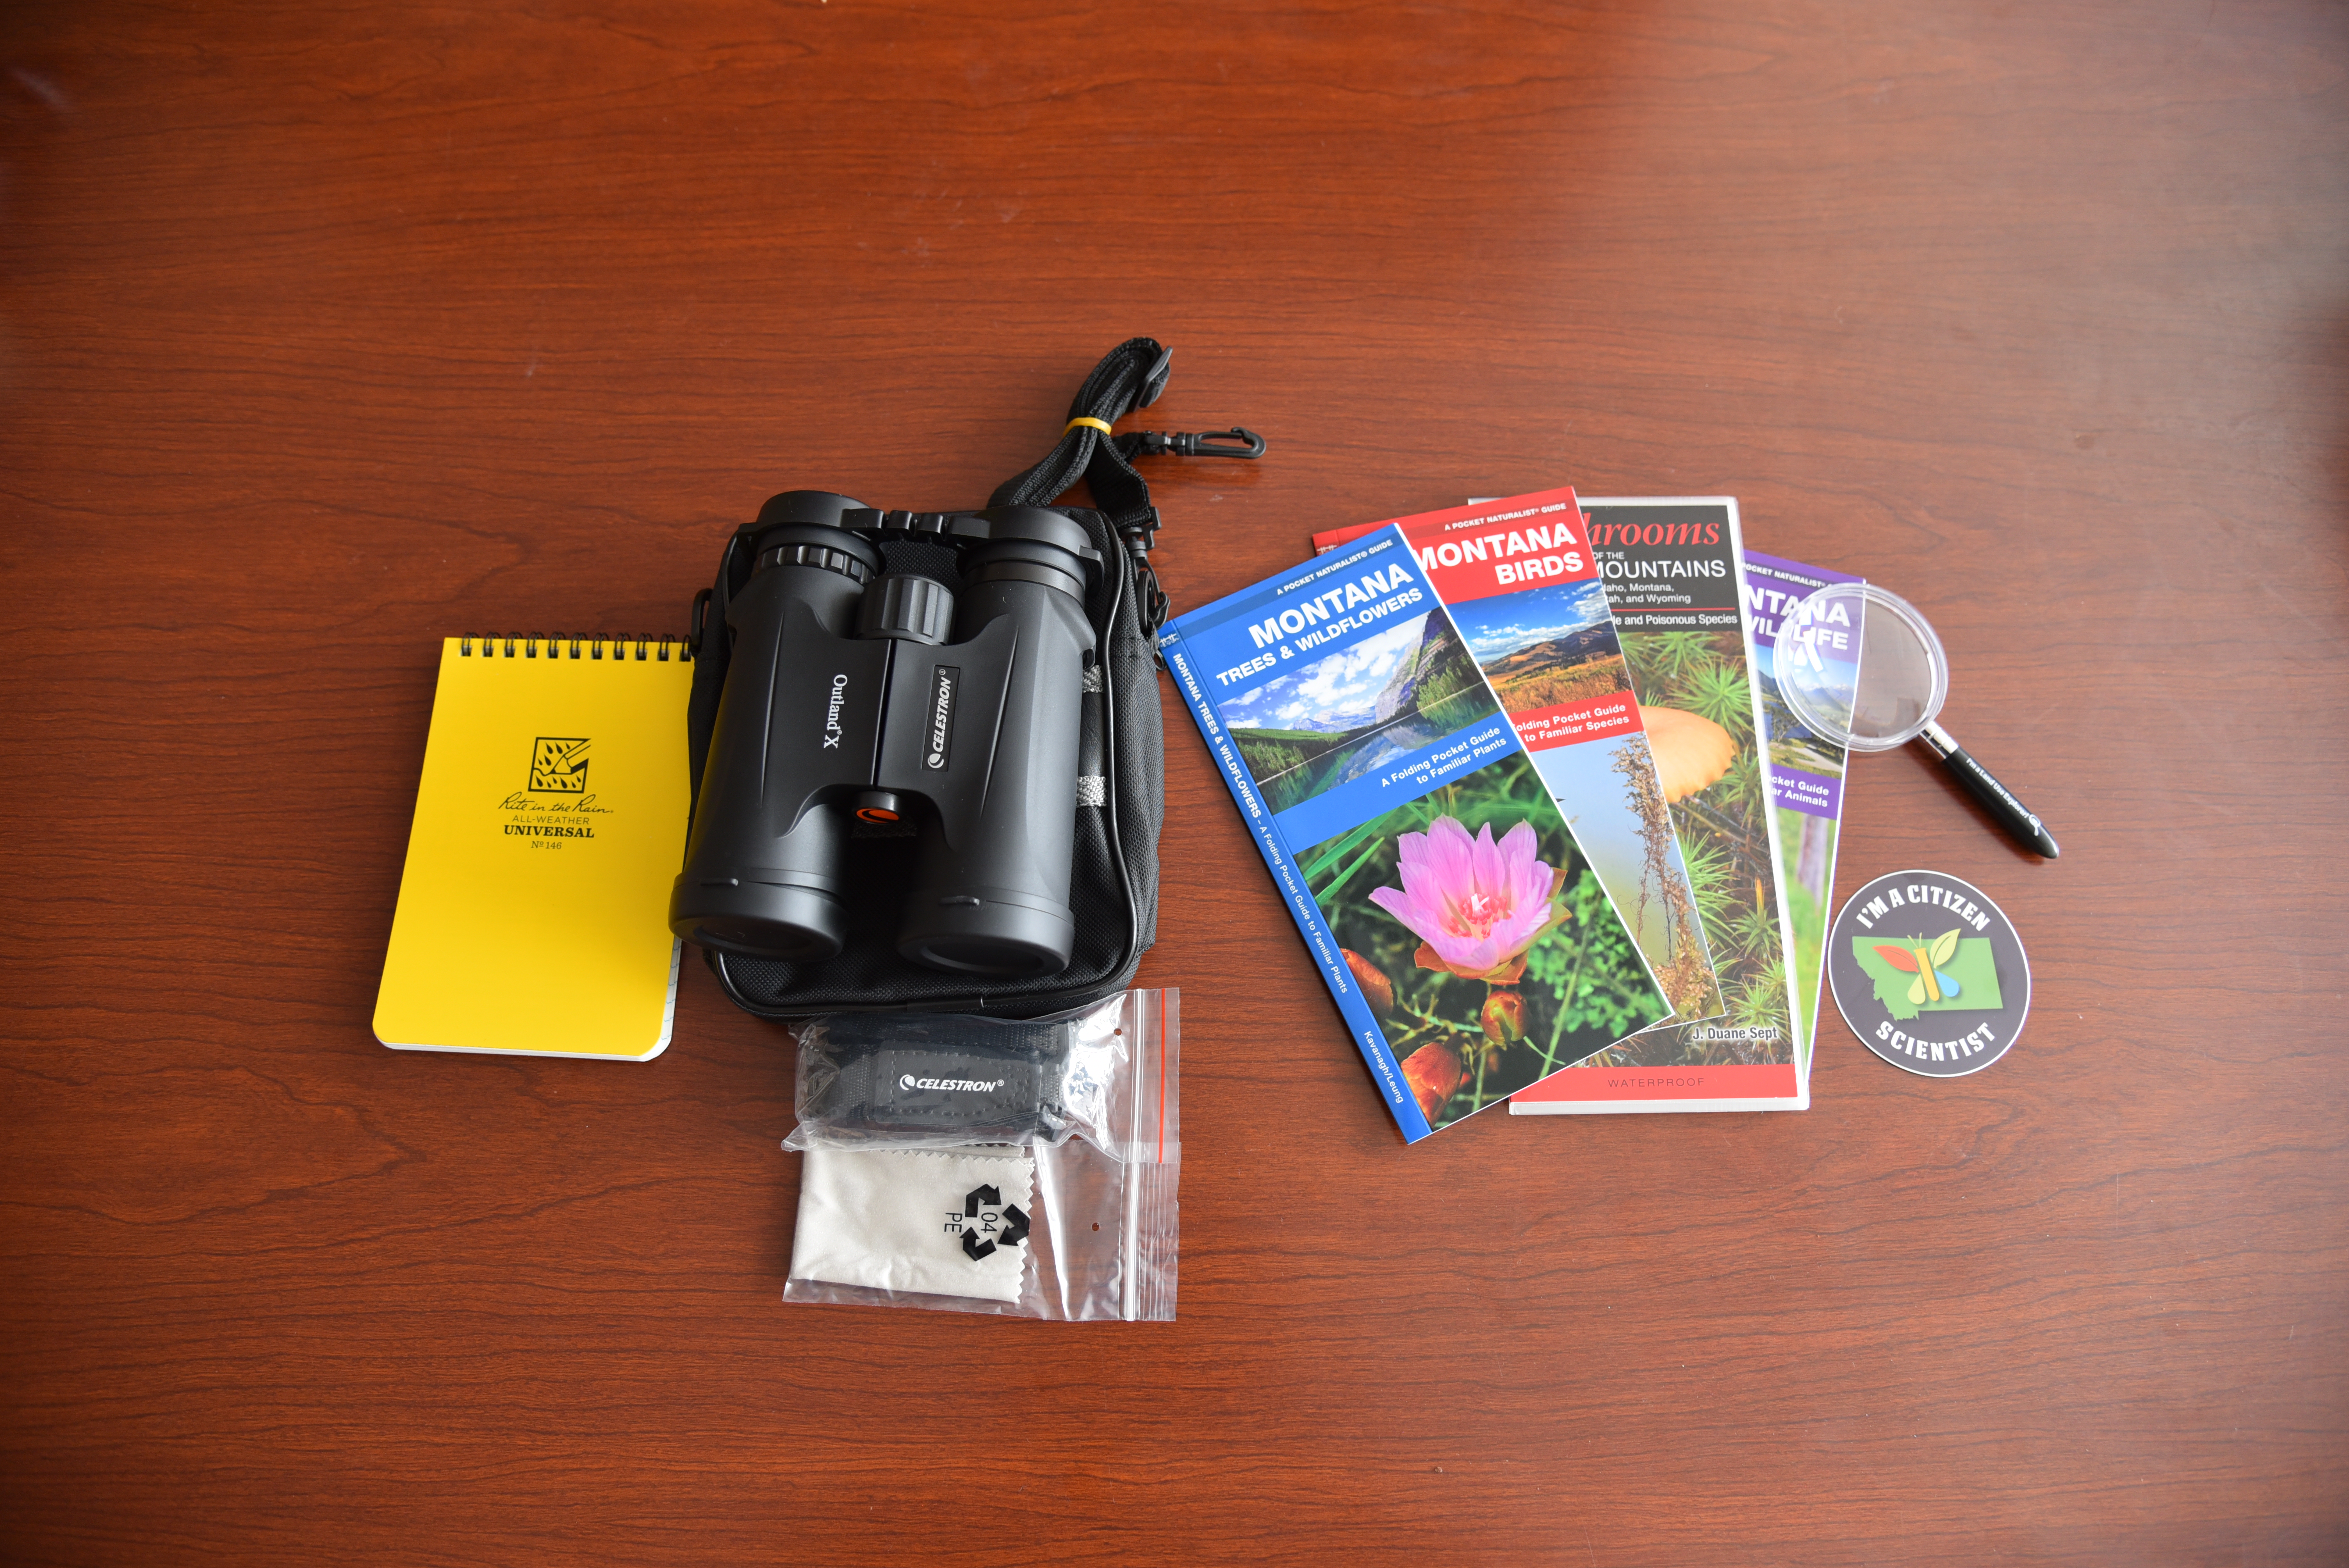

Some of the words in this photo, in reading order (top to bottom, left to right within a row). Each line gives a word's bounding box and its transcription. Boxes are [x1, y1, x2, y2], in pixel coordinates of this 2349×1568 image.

[1452, 518, 1485, 530] POCKET
[1541, 502, 1567, 514] GUIDE
[1583, 512, 1720, 546] hrooms
[1284, 574, 1315, 593] POCKET
[1368, 540, 1393, 555] GUIDE
[1495, 551, 1584, 585] BIRDS
[1593, 551, 1604, 560] OF
[1606, 551, 1625, 560] THE
[1608, 594, 1623, 604] ah,
[1626, 594, 1644, 603] and
[1646, 593, 1691, 604] Wyoming
[1629, 583, 1674, 592] Montana,
[1248, 563, 1414, 649] MONTANA
[1744, 584, 1851, 627] NTANA
[1624, 615, 1643, 625] and
[1645, 614, 1696, 625] Poisonous
[1698, 613, 1738, 626] Species
[1216, 652, 1276, 687] TREES
[1280, 645, 1295, 659] &
[1294, 588, 1423, 652] WILDFLOWERS
[1513, 720, 1550, 732] olding
[1552, 712, 1592, 725] Pocket
[1594, 704, 1626, 716] Guide
[1524, 733, 1536, 742] to
[1540, 725, 1583, 740] Familiar
[1586, 716, 1629, 731] Species
[824, 735, 839, 748] X
[1381, 777, 1389, 787] A
[1390, 760, 1430, 783] Folding
[1431, 741, 1468, 764] Pocket
[1470, 727, 1500, 745] Guide
[1416, 775, 1429, 784] to
[1430, 755, 1471, 777] Familiar
[1474, 737, 1506, 757] Plants
[498, 791, 535, 810] Rite
[549, 802, 570, 812] the
[1785, 789, 1828, 807] Animals
[1798, 781, 1829, 796] Guide
[1979, 770, 1995, 786] Land
[1993, 782, 2005, 796] Use
[2003, 792, 2029, 818] Explorer!
[504, 825, 595, 838] UNIVERSAL
[512, 815, 590, 825] ALL-WEATHER
[1173, 653, 1202, 702] MONTANA
[1198, 701, 1220, 734] TREES
[1214, 736, 1224, 745] &
[1219, 744, 1262, 818] WILDFLOWERS
[1259, 825, 1267, 834] A
[1264, 833, 1282, 865] Folding
[1280, 864, 1298, 895] Pocket
[1295, 895, 1310, 920] Guide
[1308, 920, 1315, 931] to
[1313, 931, 1334, 965] Familiar
[1331, 966, 1347, 994] Plants
[1856, 896, 1889, 929] I'M
[1889, 888, 1905, 908] A
[1907, 885, 1990, 932] CITIZEN
[1693, 1028, 1704, 1040] J.
[1707, 1028, 1746, 1040] Duane
[1749, 1026, 1777, 1041] Sept
[1875, 1021, 1995, 1061] SCIENTIST
[1364, 1031, 1404, 1104] Kavanagh/Leung
[1608, 1078, 1705, 1088] WATERPROOF
[944, 1212, 962, 1233] PE
[980, 1212, 998, 1233] 04
